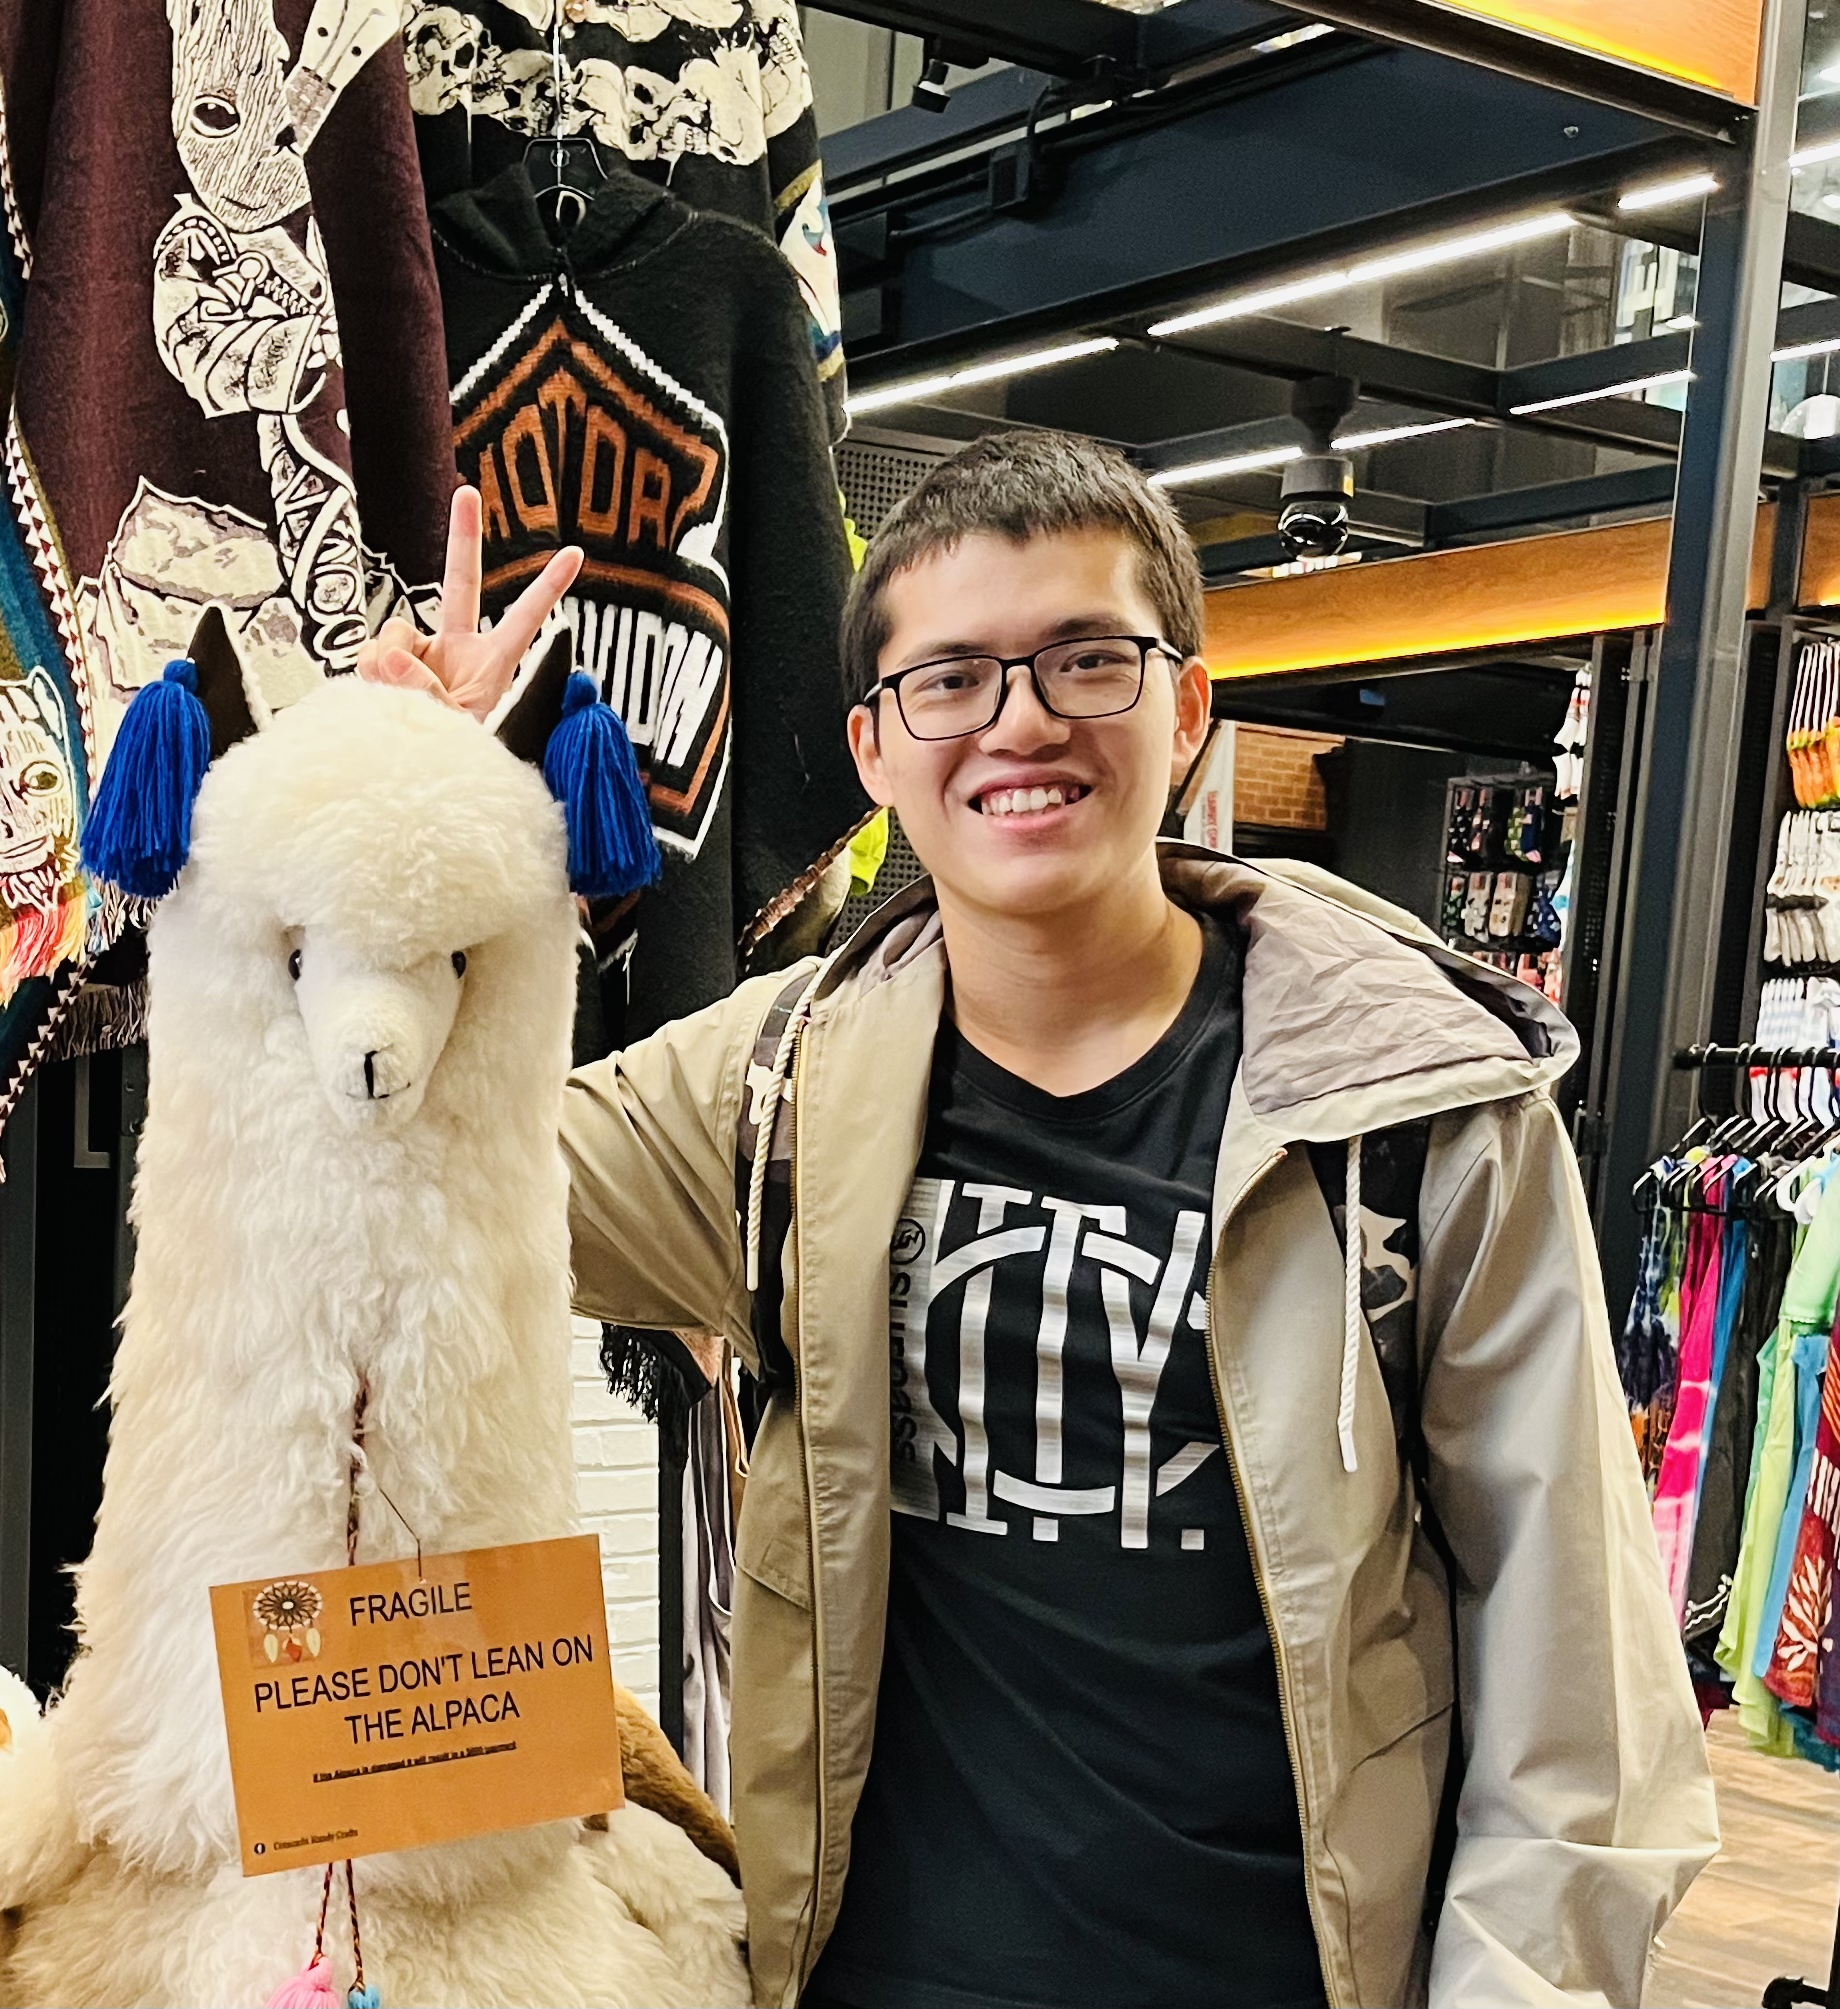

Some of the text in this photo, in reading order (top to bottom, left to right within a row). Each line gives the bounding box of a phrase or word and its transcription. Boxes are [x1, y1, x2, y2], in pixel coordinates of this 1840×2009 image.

[349, 1582, 472, 1626] FRAGILE
[254, 1634, 593, 1712] PLEASE DON'T LEAN ON
[344, 1691, 520, 1745] THE ALPACA
